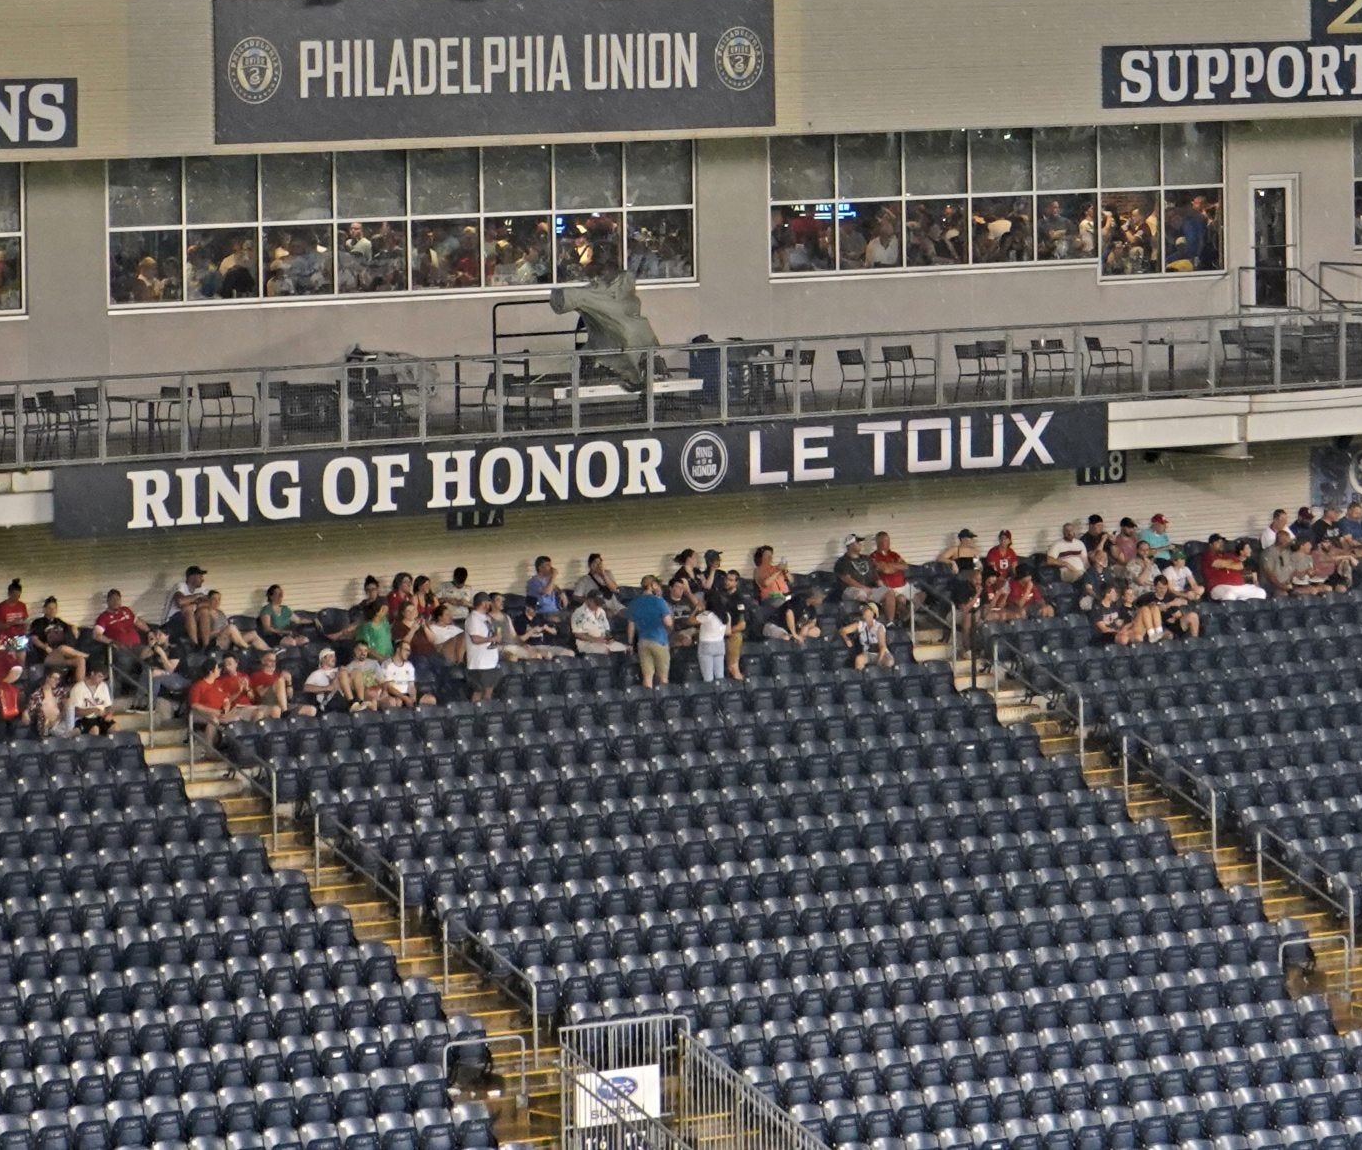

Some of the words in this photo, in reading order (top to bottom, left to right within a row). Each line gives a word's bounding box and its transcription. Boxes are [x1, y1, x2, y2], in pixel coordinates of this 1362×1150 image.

[299, 33, 571, 99] PHILADELPHIA
[584, 32, 698, 90] UNION
[126, 459, 302, 529] RING
[322, 453, 411, 516] OF
[426, 438, 667, 510] HONOR
[692, 464, 717, 477] HONOR
[748, 424, 836, 486] LE
[856, 409, 1056, 477] TOUX
